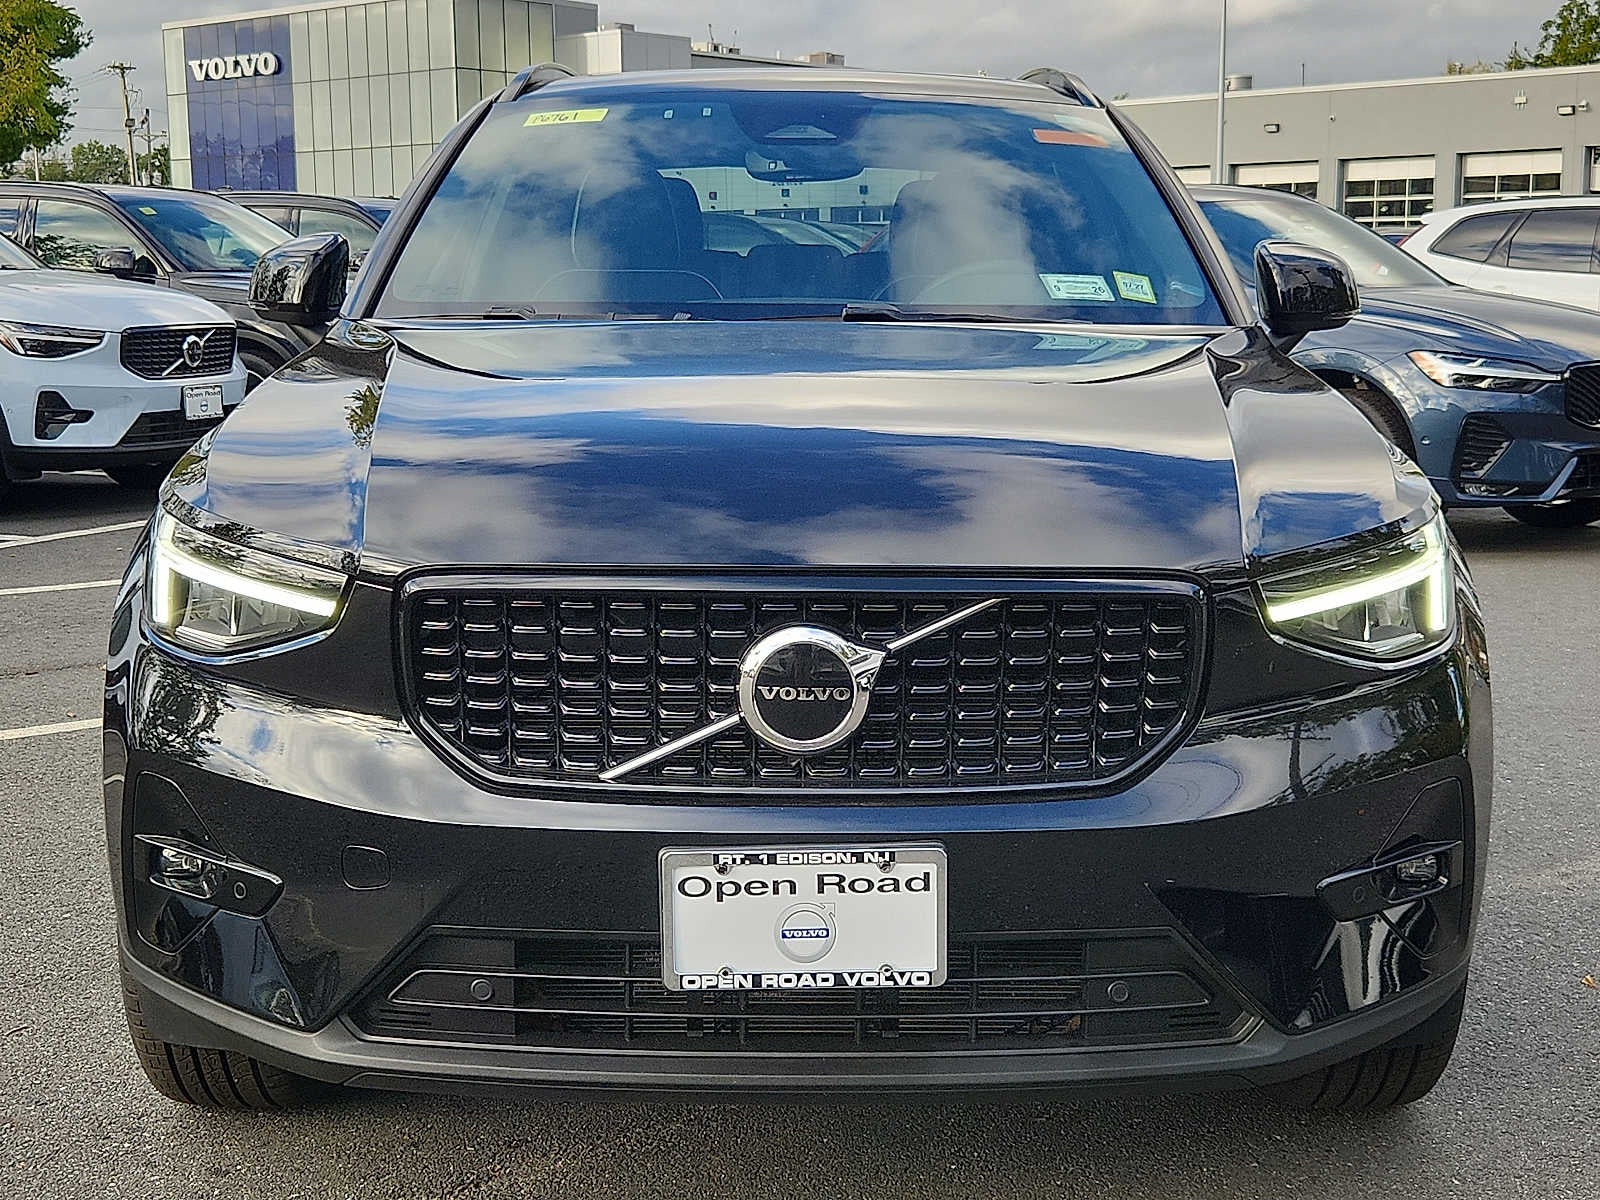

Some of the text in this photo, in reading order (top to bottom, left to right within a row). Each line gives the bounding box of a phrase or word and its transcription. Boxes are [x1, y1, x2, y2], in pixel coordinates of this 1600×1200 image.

[188, 52, 278, 81] VOLVO
[757, 686, 851, 701] VOLVO
[759, 854, 768, 865] 1
[776, 852, 857, 865] EDISON,
[863, 851, 890, 863] NJ
[677, 871, 931, 902] Open Road
[783, 930, 828, 938] VOLVO
[681, 971, 931, 989] OPEN ROAD VOLVO
